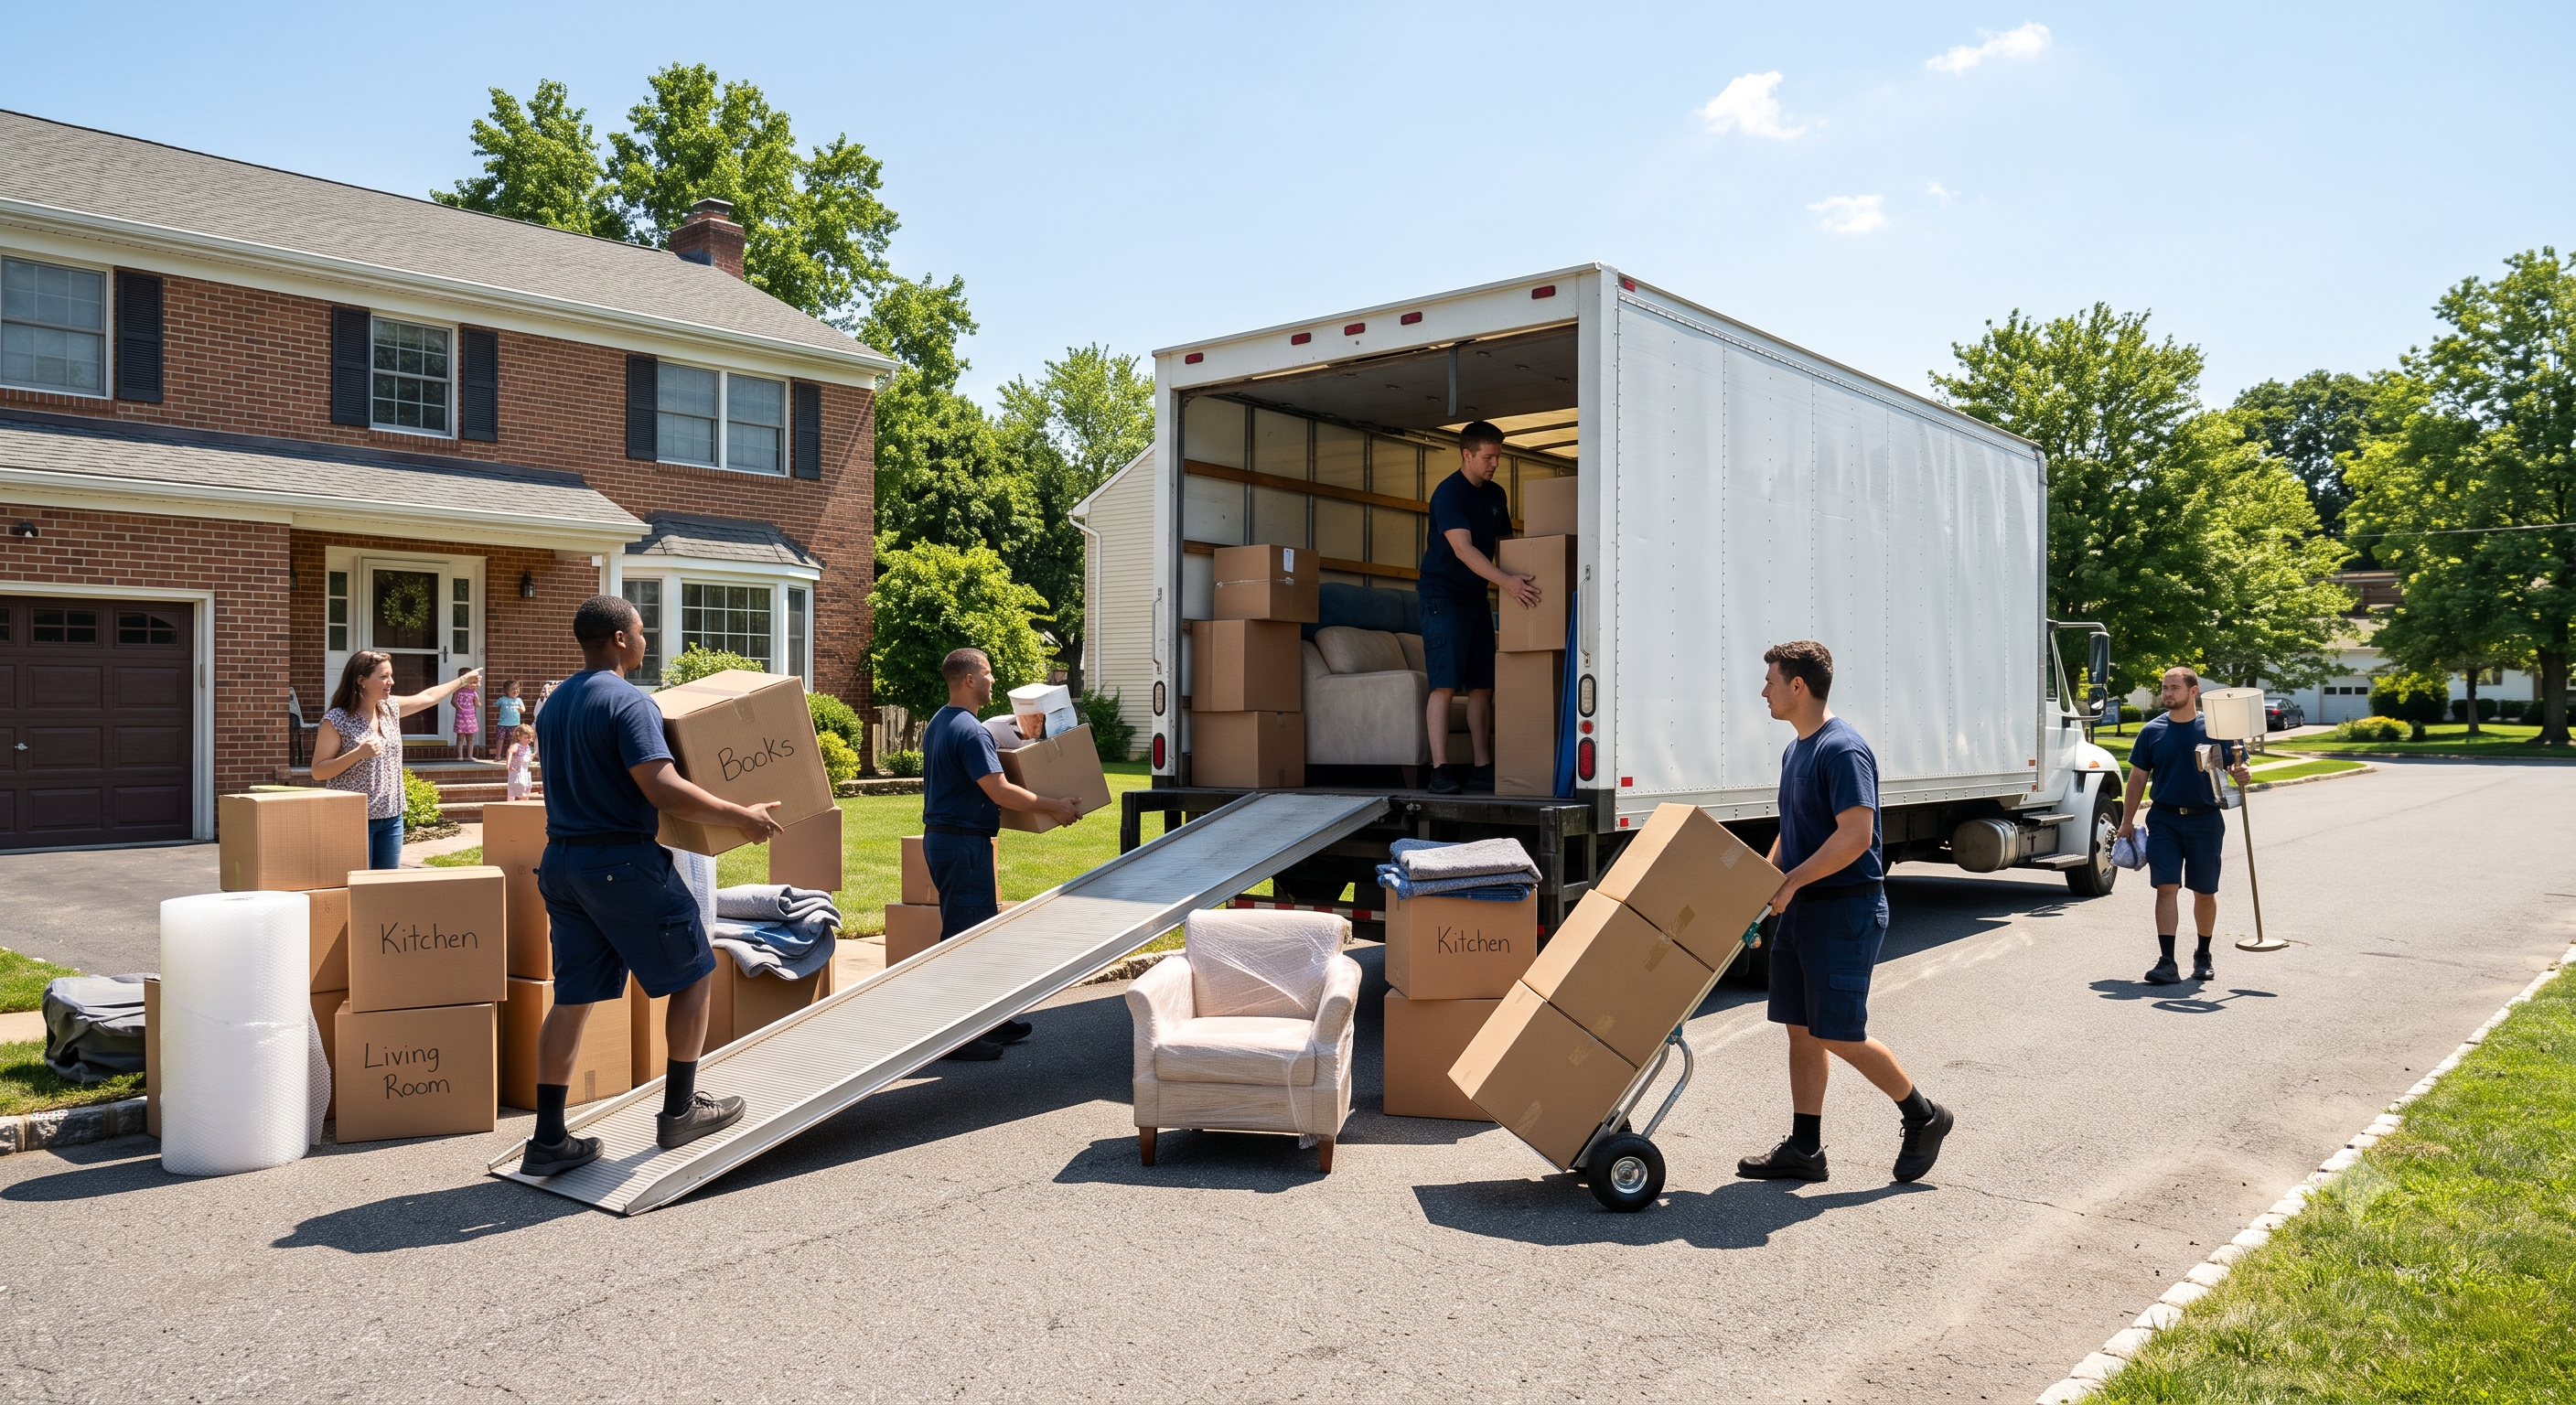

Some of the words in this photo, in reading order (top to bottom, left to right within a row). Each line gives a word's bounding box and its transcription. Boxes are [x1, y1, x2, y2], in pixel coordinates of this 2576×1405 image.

[718, 737, 794, 781] Books
[381, 922, 478, 954] Kitchen
[1438, 926, 1509, 954] Kitchen
[364, 1043, 439, 1073] Living
[383, 1073, 450, 1099] Room
